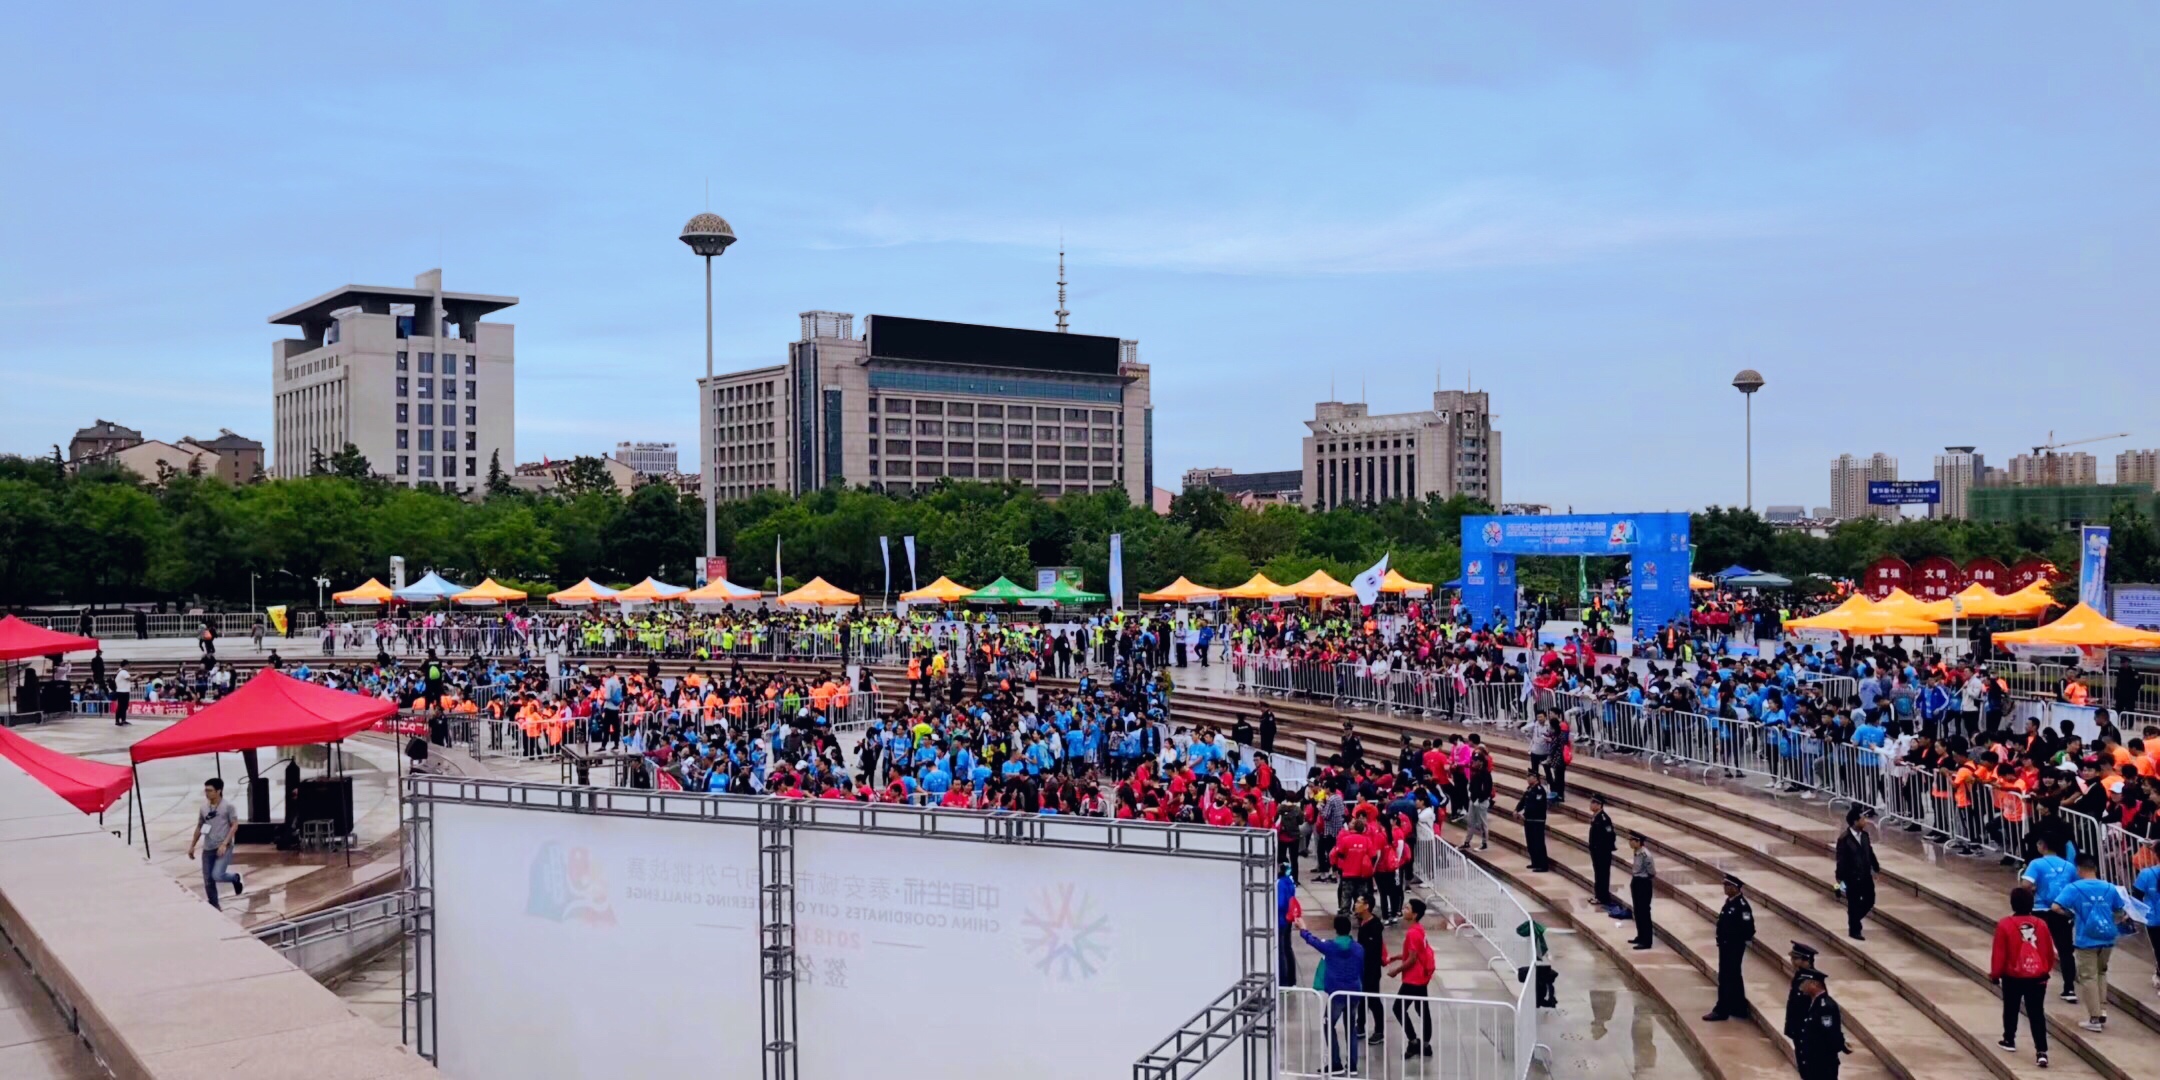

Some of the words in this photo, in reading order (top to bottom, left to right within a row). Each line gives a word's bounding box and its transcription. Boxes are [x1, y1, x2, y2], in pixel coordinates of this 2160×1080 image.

[1878, 568, 1901, 579] 富强
[1925, 569, 1947, 579] 文明
[1974, 569, 1995, 580] 自由
[2022, 571, 2047, 580] 公正
